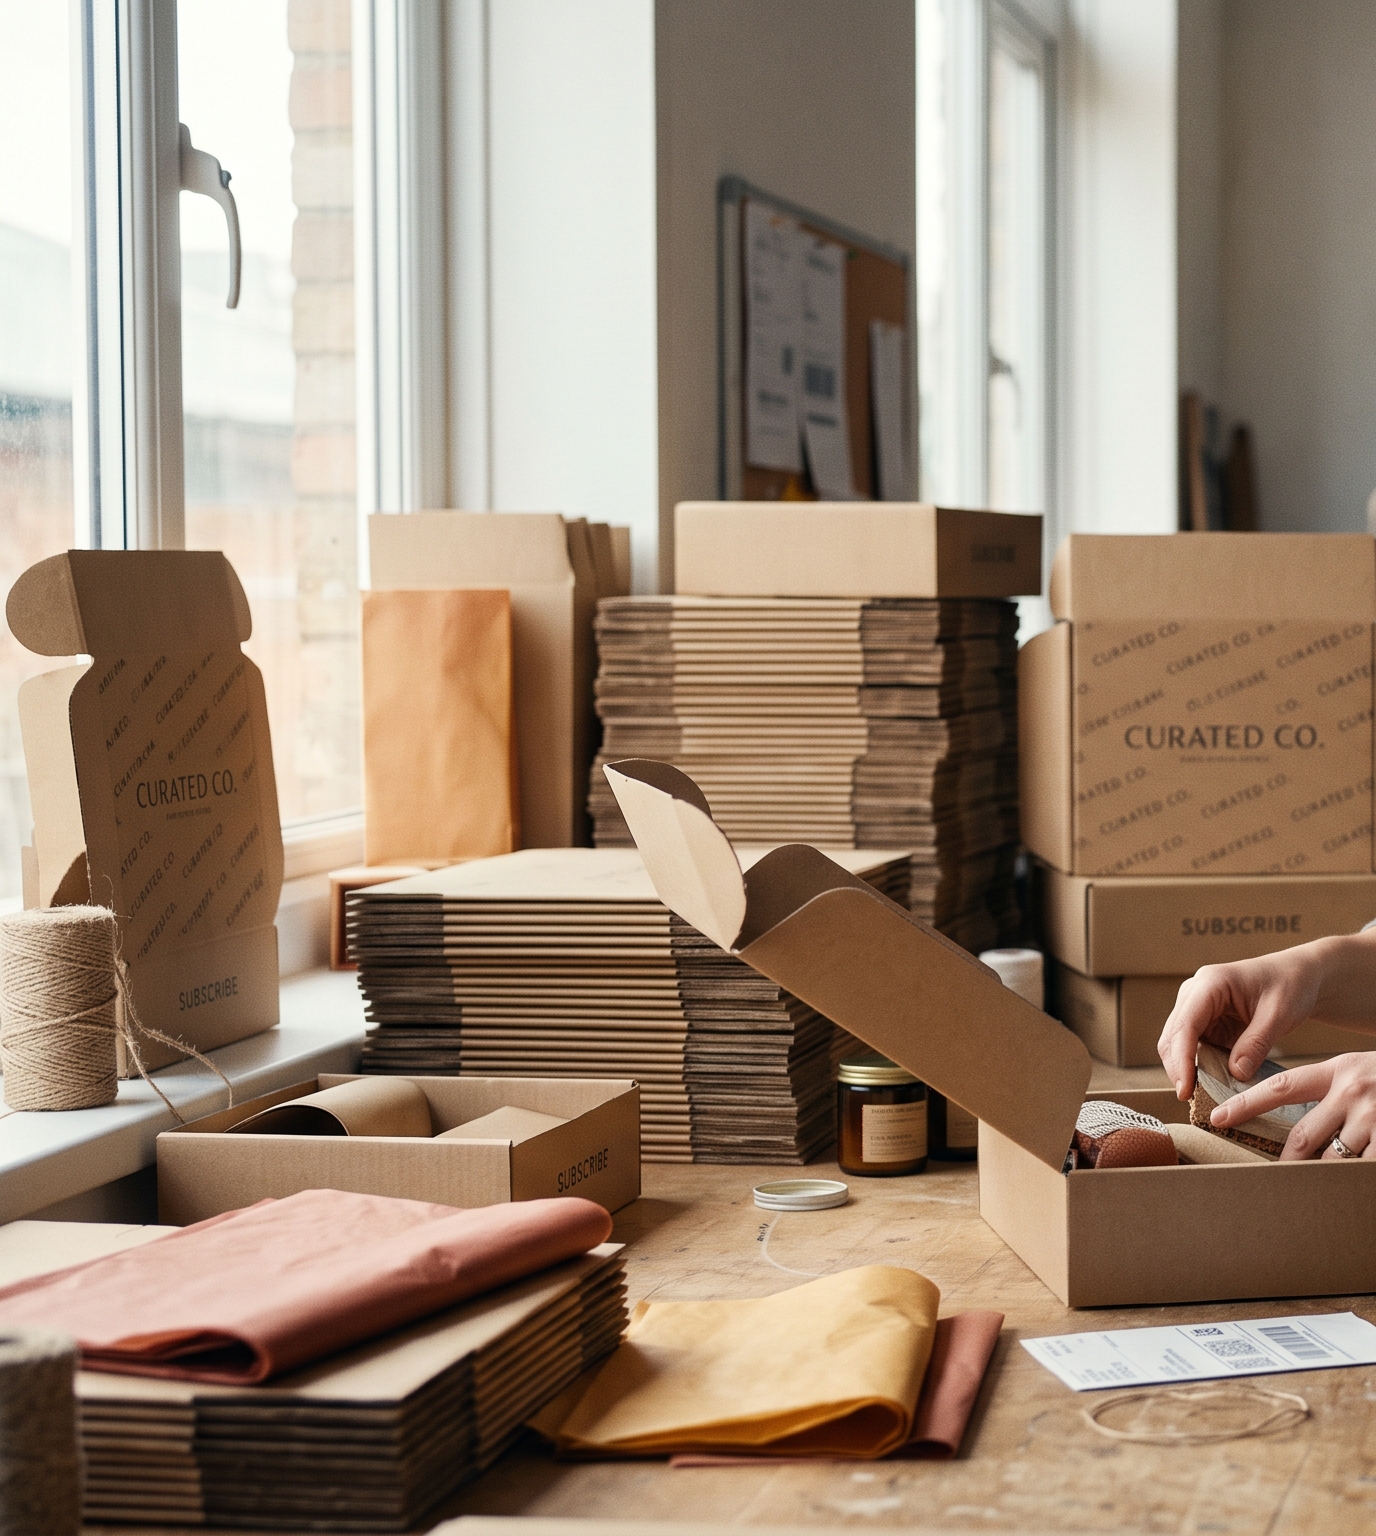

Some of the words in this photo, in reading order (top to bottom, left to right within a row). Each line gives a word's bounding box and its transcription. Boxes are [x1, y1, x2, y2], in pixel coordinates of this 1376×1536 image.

[1092, 631, 1156, 667] CURATED
[1166, 641, 1230, 675] CURATED
[1276, 633, 1342, 669] CURATED
[1124, 724, 1265, 750] CURATED
[1274, 724, 1326, 750] CO.
[136, 773, 208, 809] CURATED
[212, 769, 238, 798] CO.
[1200, 783, 1264, 820] CURATED
[1290, 786, 1355, 822] CURATED
[1100, 800, 1164, 835] CURATED
[120, 847, 138, 879] ATED
[1181, 913, 1301, 936] SUBSCRIBE
[179, 975, 239, 1012] SUBSCRIBE
[557, 1147, 609, 1193] SUBSCRIBE
